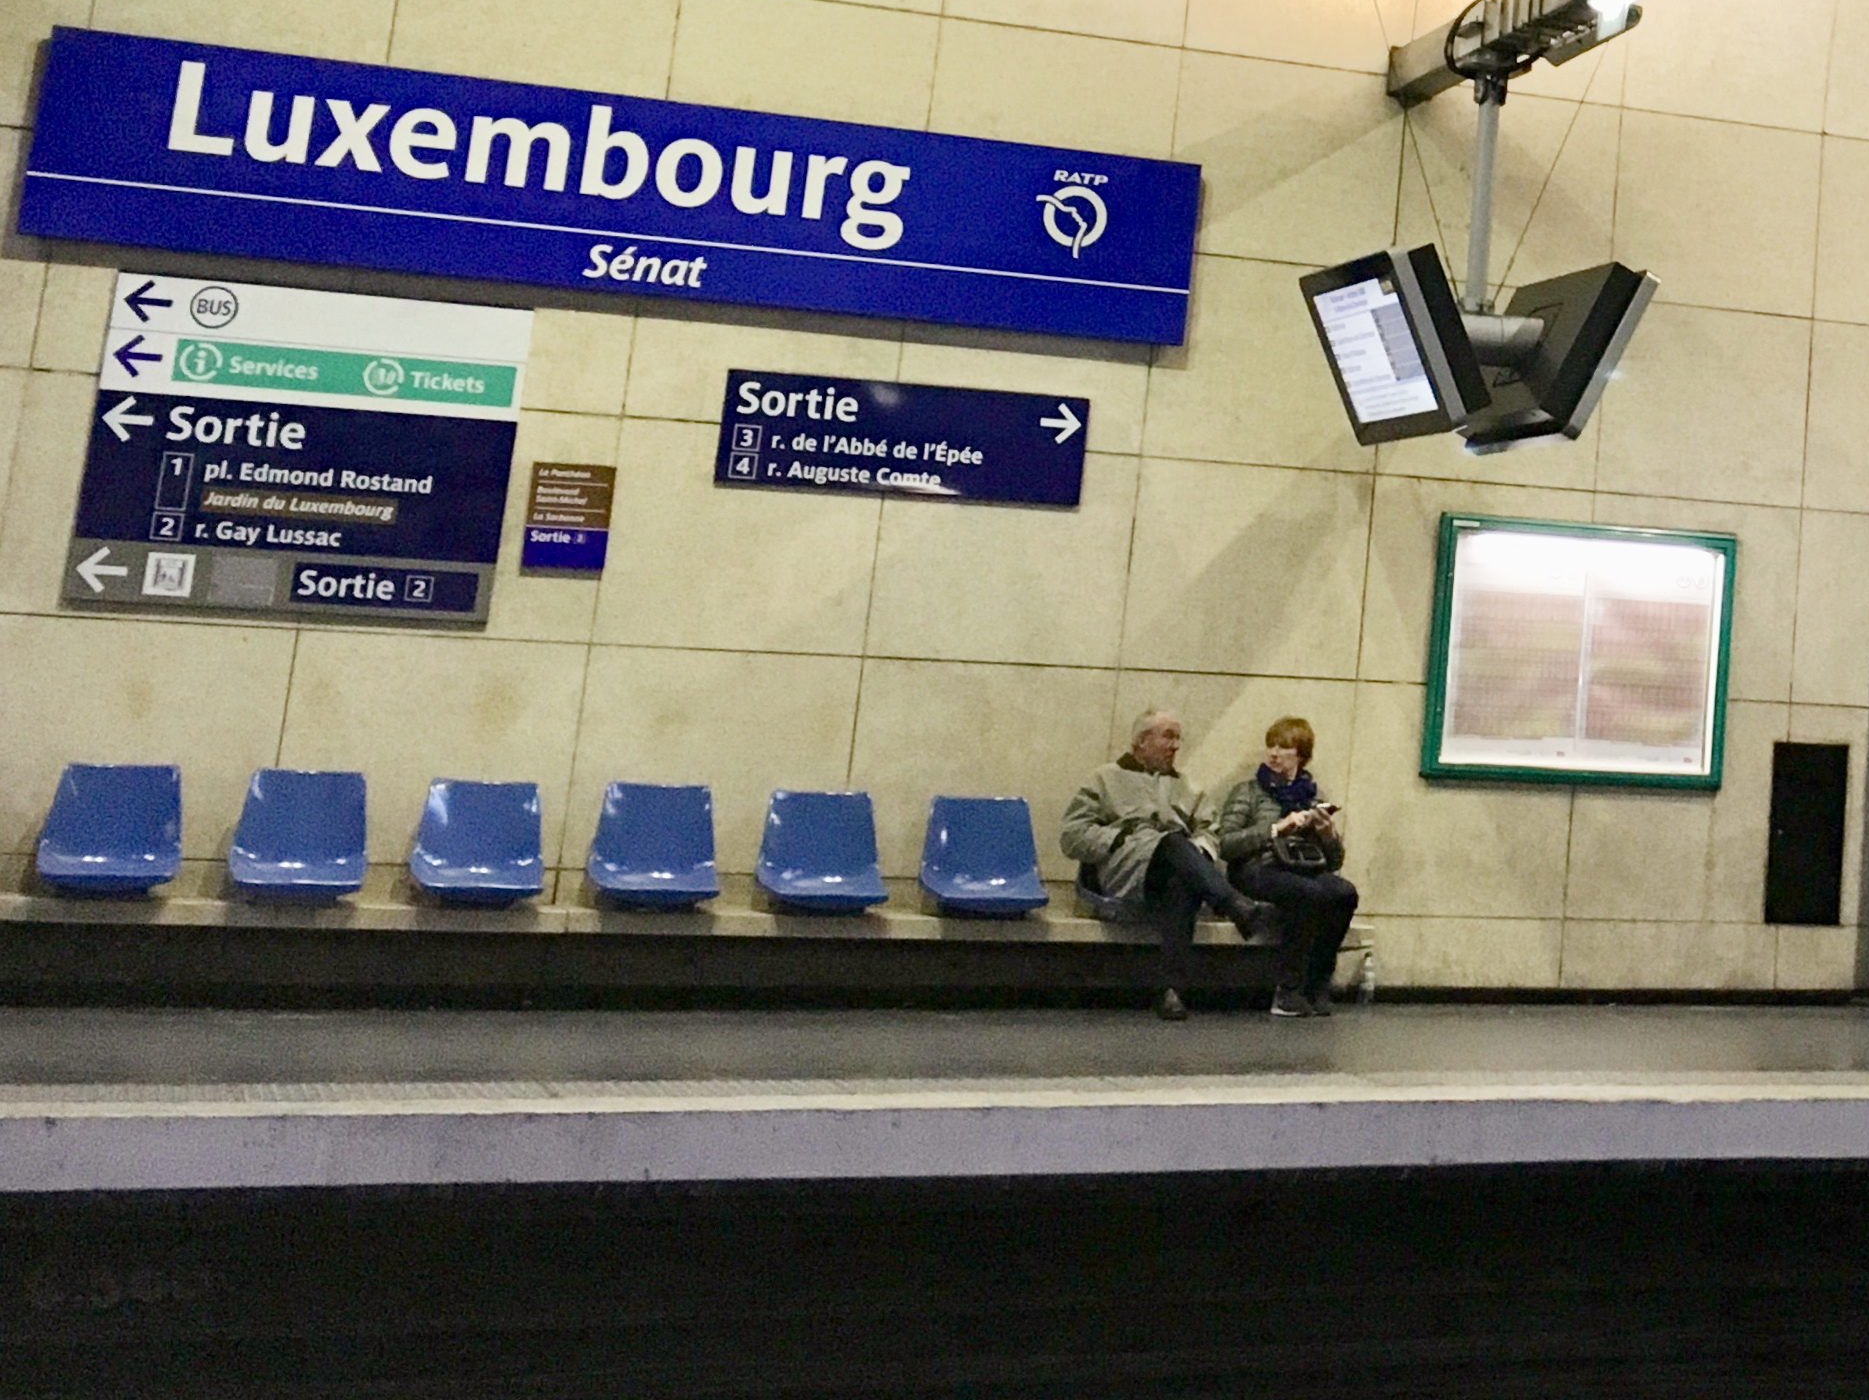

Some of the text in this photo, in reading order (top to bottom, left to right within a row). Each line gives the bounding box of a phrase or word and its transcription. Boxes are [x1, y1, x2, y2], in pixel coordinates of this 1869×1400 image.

[166, 60, 911, 251] Luxembourg
[1053, 169, 1109, 186] RATP
[582, 244, 708, 288] Sénat
[196, 299, 233, 316] BUS
[229, 356, 486, 394] Services Tickets
[736, 381, 859, 423] Sortie
[165, 405, 306, 450] Sortie
[740, 429, 754, 447] 3
[771, 435, 785, 450] r.
[792, 433, 817, 452] de
[893, 441, 918, 459] de
[171, 457, 433, 494] 1 pl. Edmond Rostand
[735, 457, 941, 487] 4 r. Auguste Comte
[204, 491, 395, 521] Jardin du Luxembourg
[159, 517, 342, 547] 2 r. Gay Lussac
[530, 529, 571, 544] Sortie
[297, 569, 427, 601] Sortie 2
